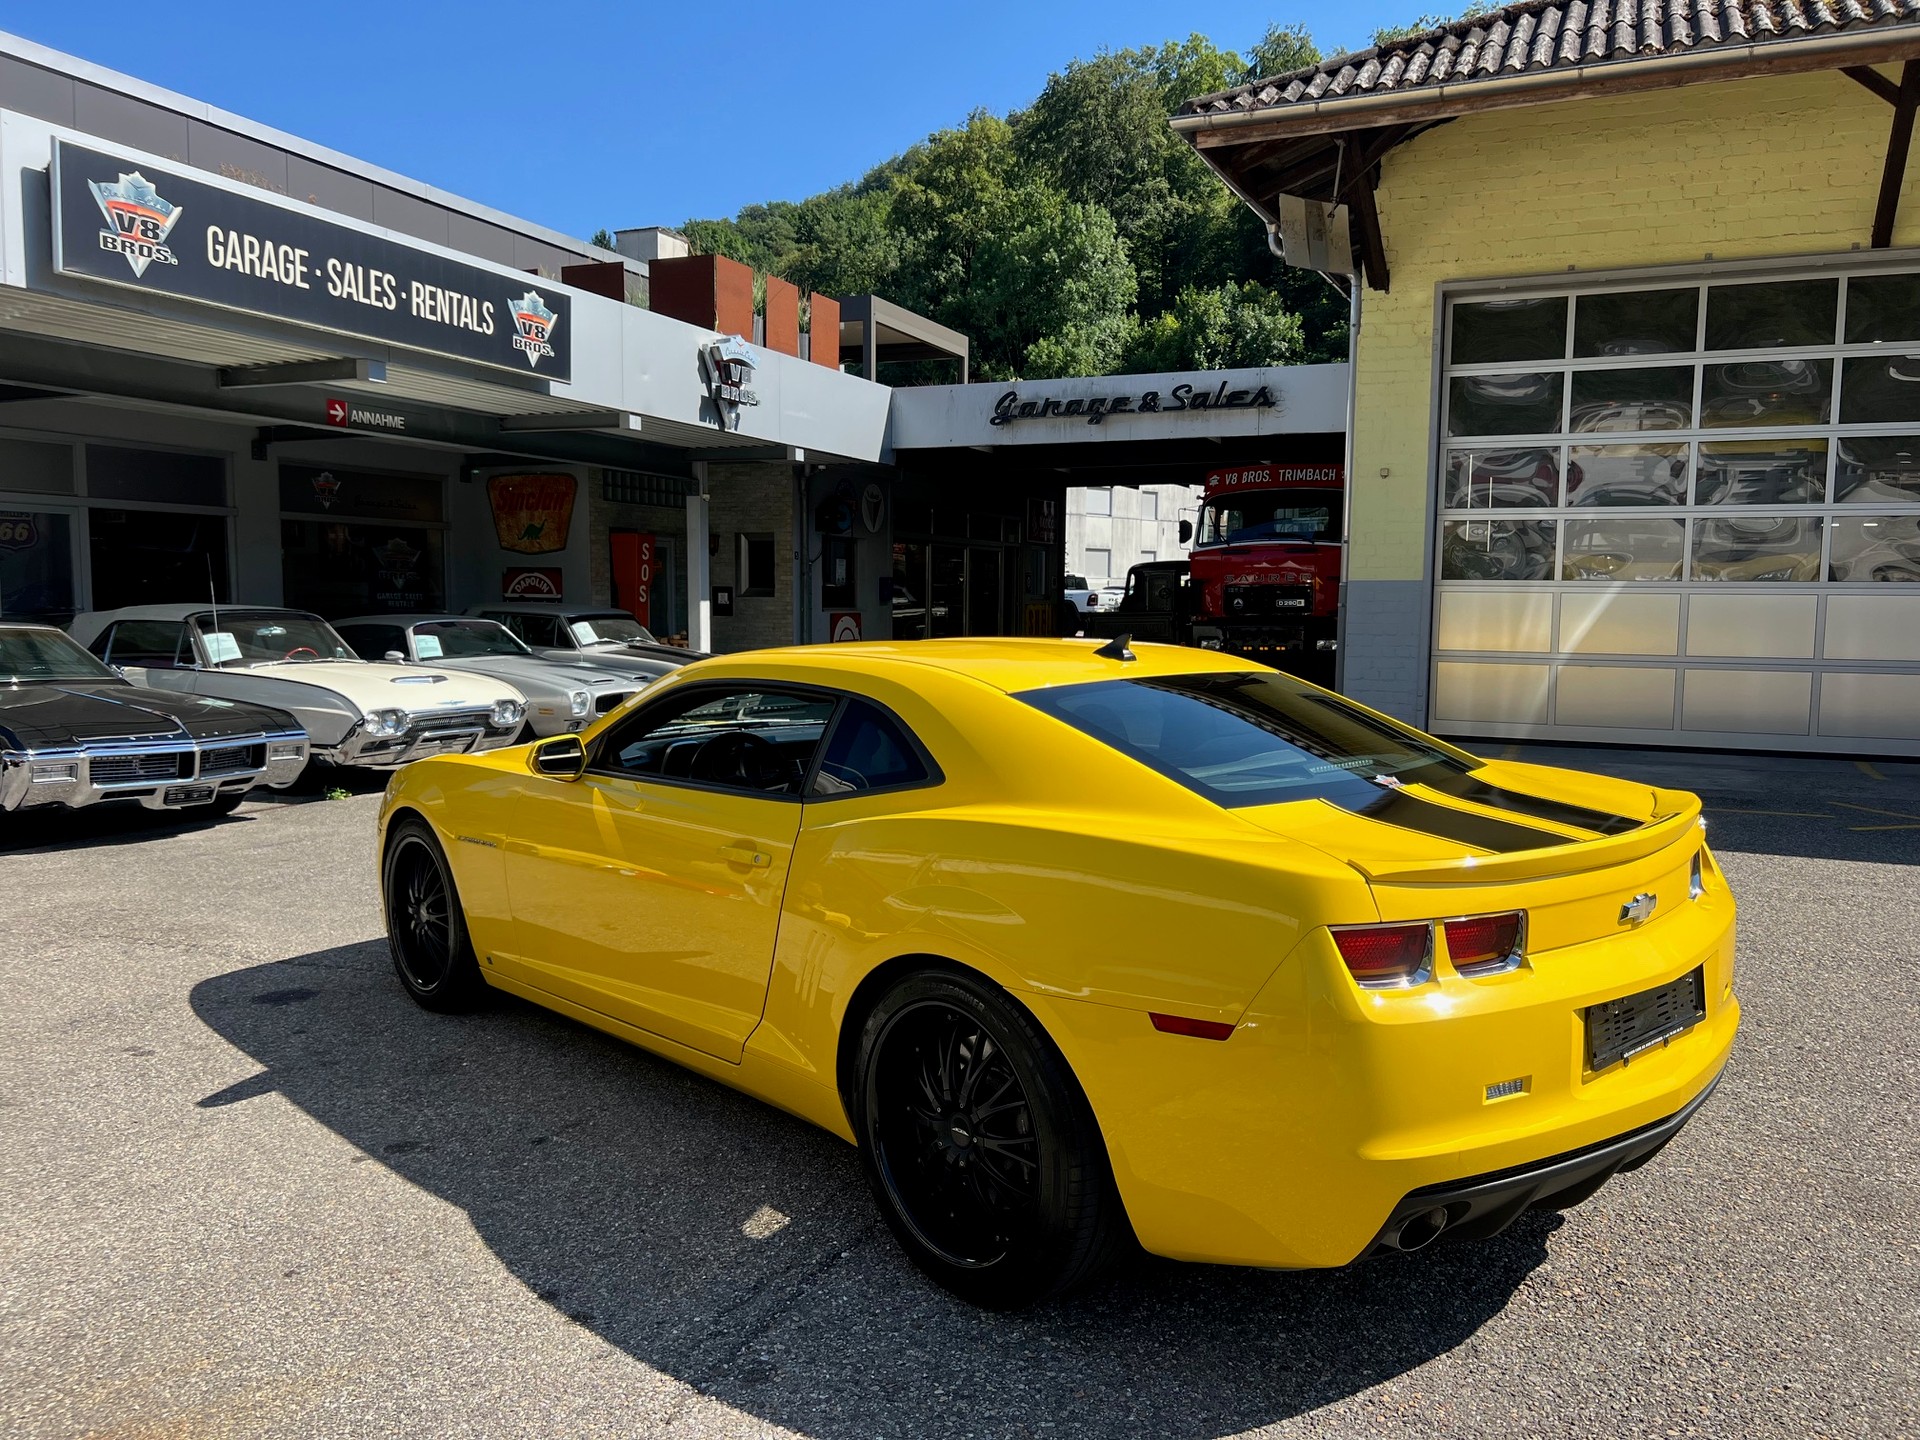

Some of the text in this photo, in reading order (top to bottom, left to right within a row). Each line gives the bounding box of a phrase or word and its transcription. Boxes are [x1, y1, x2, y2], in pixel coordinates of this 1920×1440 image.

[113, 208, 161, 242] V8
[99, 231, 178, 265] BROS.
[207, 225, 495, 336] GARAGE SALES RENTALS
[520, 319, 546, 341] V8
[513, 334, 555, 357] BROS.
[989, 380, 1276, 425] Garage & Sales
[351, 409, 405, 431] ANNAHME
[1225, 468, 1336, 486] V8 BROS. TRIMBACH
[496, 483, 570, 512] Sinclair
[0, 522, 30, 542] 66
[639, 542, 650, 604] SOS
[1224, 572, 1312, 583] SAURER
[515, 576, 550, 594] DAPOLIN
